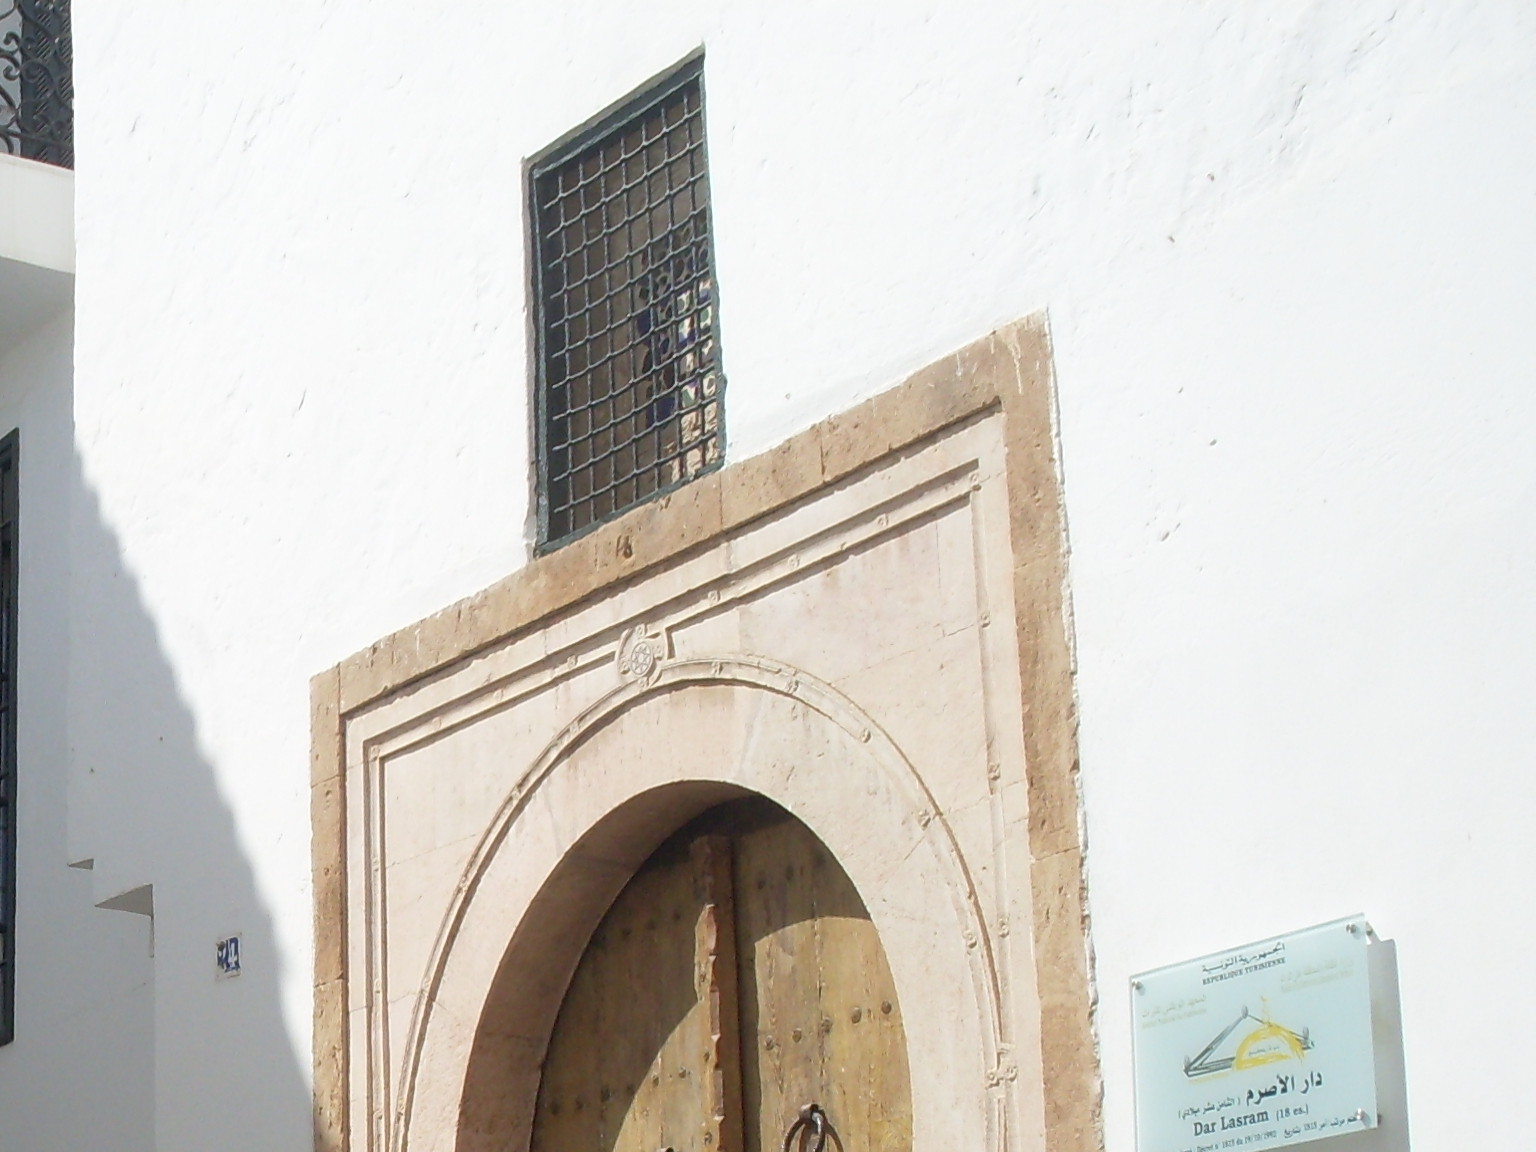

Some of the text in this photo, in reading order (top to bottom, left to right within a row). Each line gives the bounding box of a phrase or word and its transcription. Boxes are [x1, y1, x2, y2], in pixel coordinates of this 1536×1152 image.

[1202, 941, 1286, 974] الجمهورية التونسية
[1202, 968, 1244, 986] REPUBLIQUE
[1245, 957, 1286, 974] TUNISIENNE
[1246, 1073, 1295, 1107] الأصرم
[1300, 1071, 1323, 1094] دار
[1193, 1121, 1217, 1137] Dar
[1220, 1110, 1270, 1131] Lasram
[1275, 1107, 1291, 1122] (18
